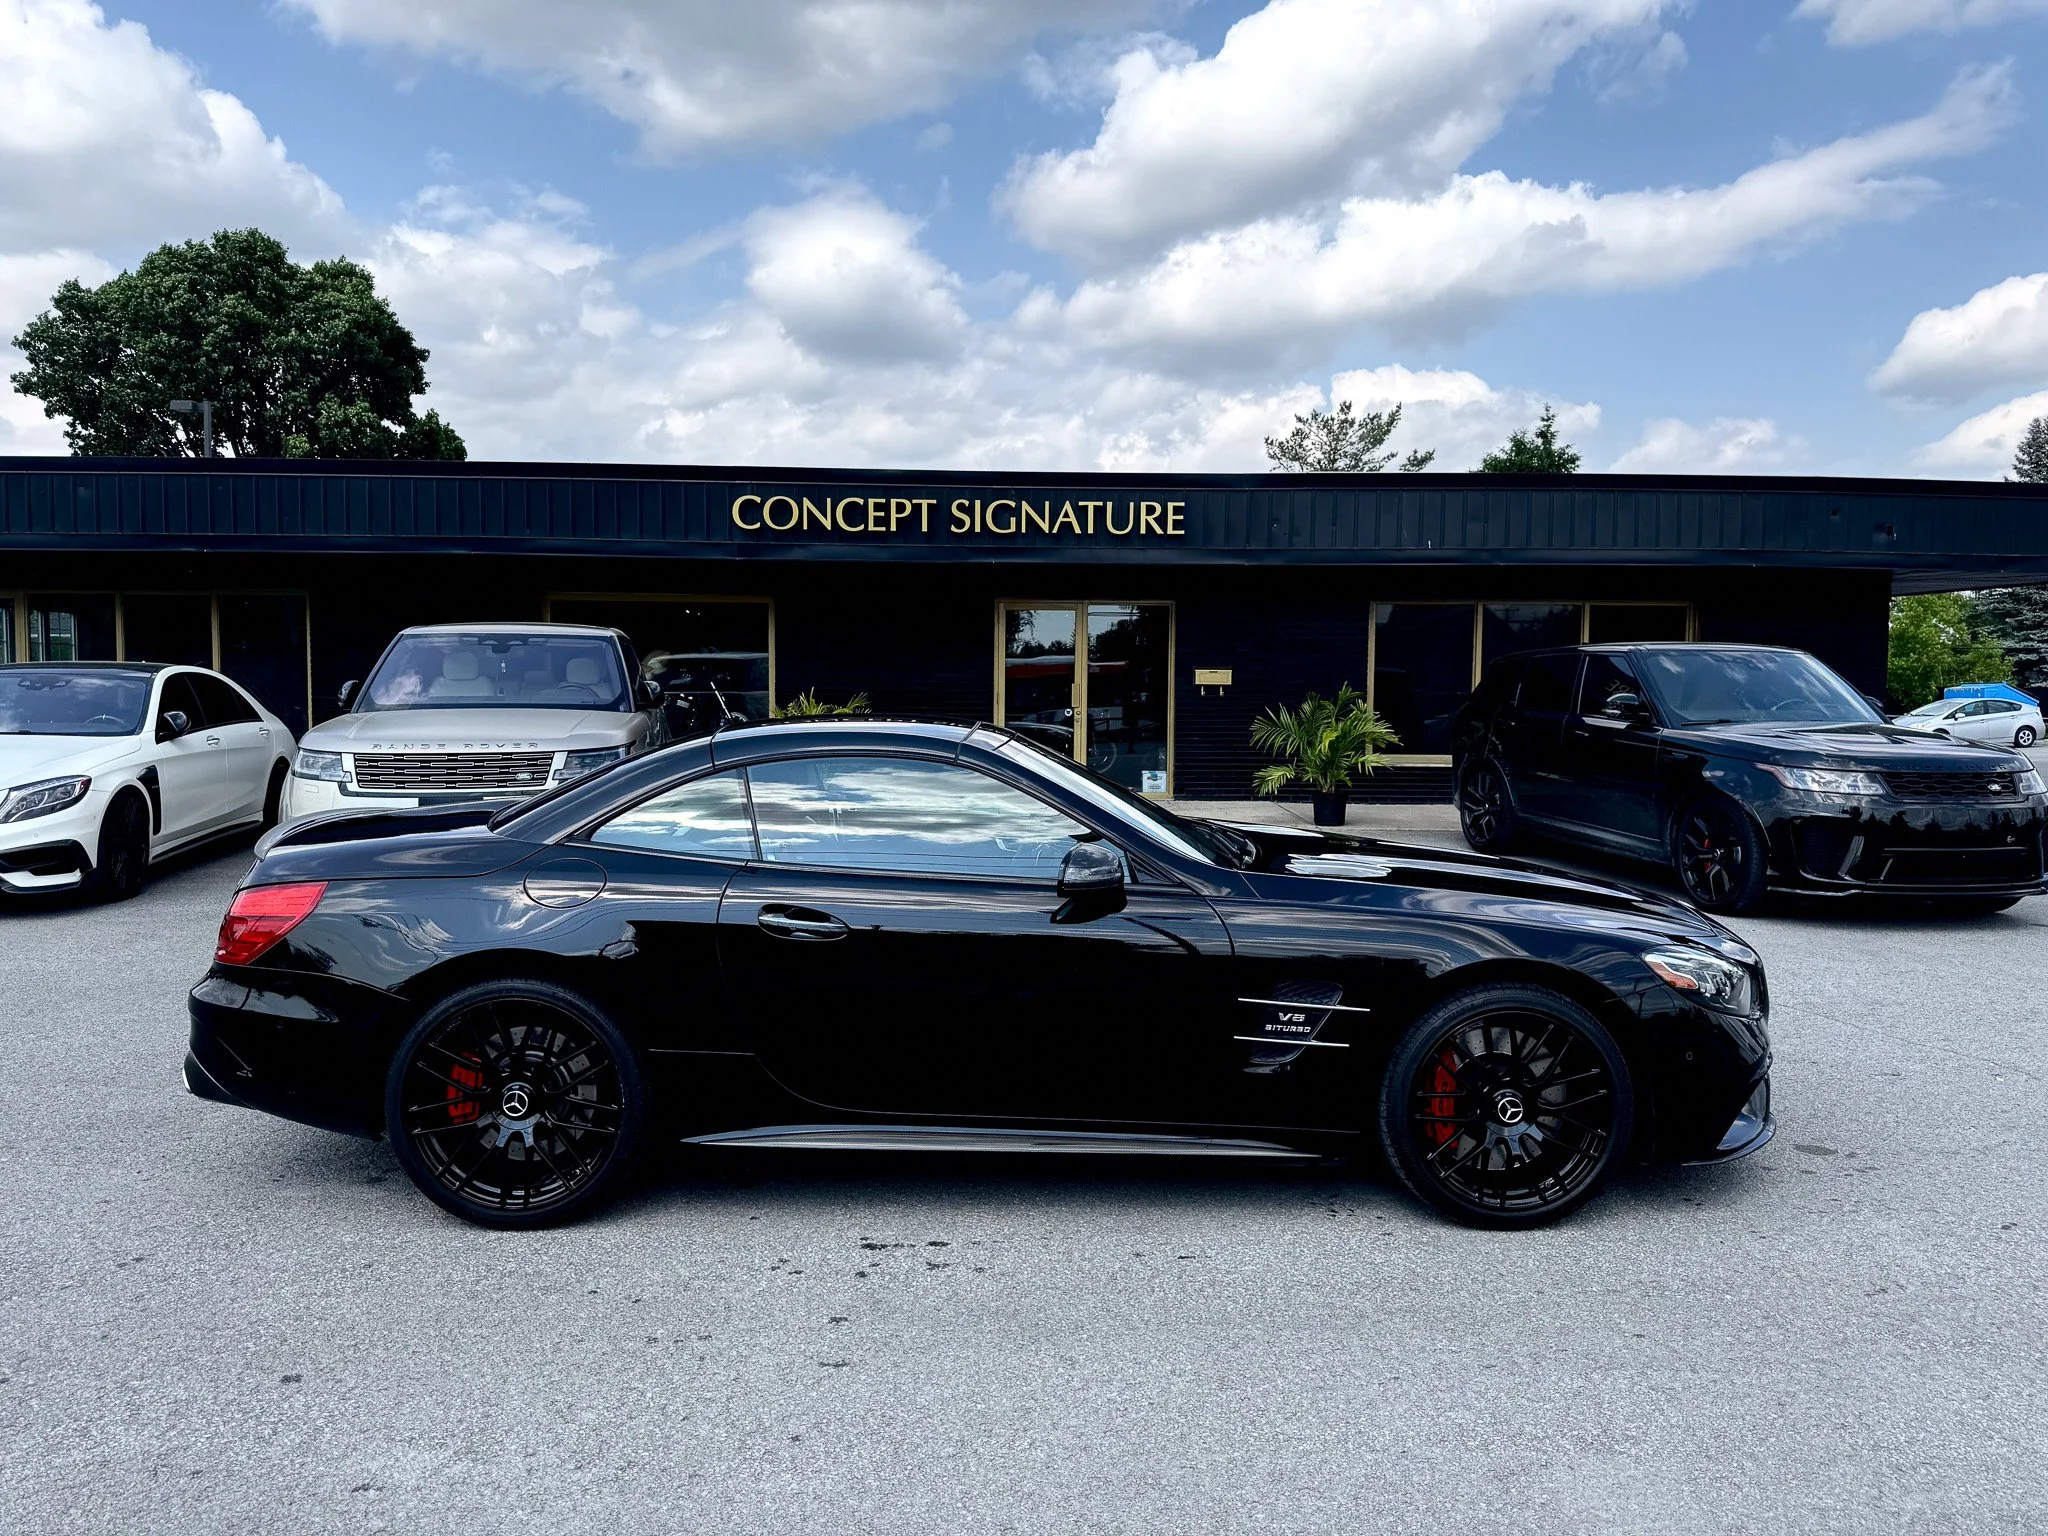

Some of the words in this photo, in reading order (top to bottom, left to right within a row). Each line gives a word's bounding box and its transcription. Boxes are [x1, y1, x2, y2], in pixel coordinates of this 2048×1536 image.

[731, 495, 937, 533] CONCEPT
[950, 498, 1186, 535] SIGNATURE
[1278, 1012, 1306, 1022] V8
[1264, 1024, 1312, 1033] BITURBO
